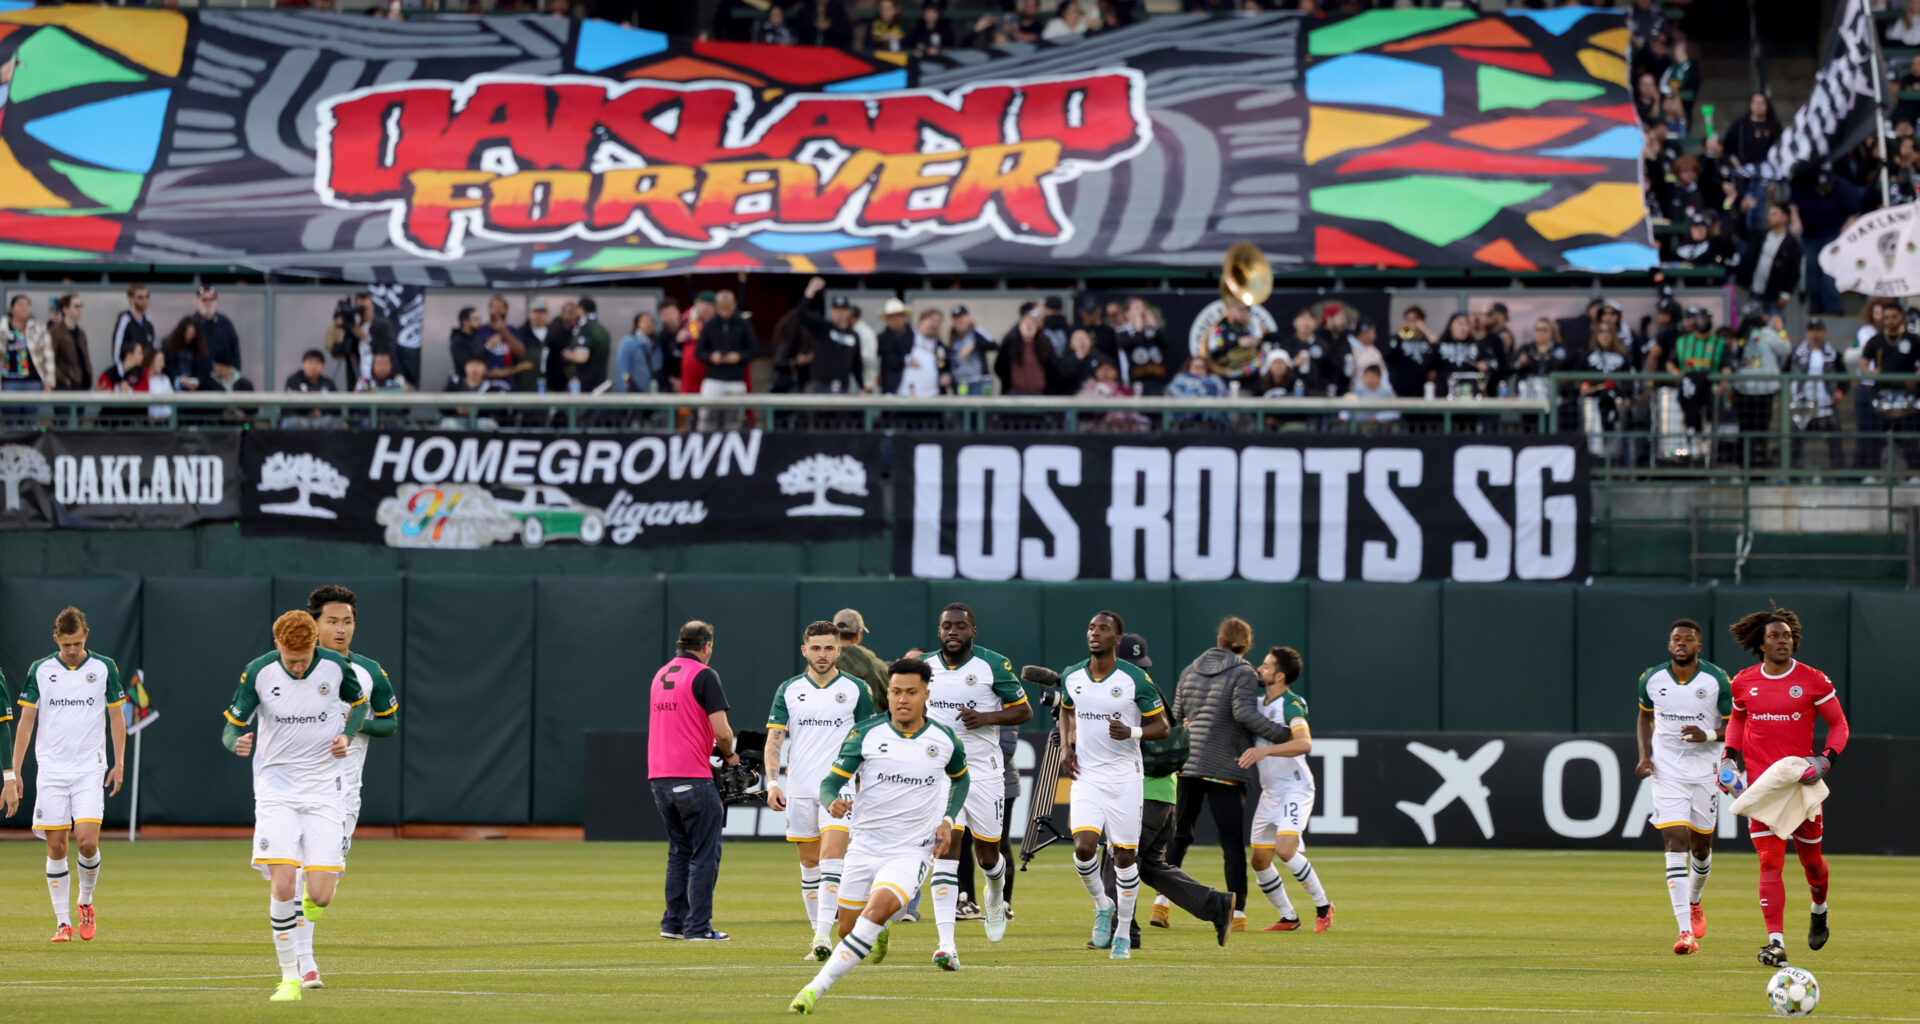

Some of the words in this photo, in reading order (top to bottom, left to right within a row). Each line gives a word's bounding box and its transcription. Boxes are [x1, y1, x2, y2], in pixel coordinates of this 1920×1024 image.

[327, 72, 1138, 197] OAKLAND
[406, 136, 1062, 250] FOREVER
[369, 429, 762, 484] HOMEGROWN
[54, 455, 224, 505] OAKLAND
[911, 444, 1082, 582] LOS
[1107, 446, 1423, 582] ROOTS
[1452, 445, 1576, 581] SG
[1132, 644, 1141, 656] S
[49, 697, 85, 706] Anthem
[930, 699, 965, 709] Anthem
[275, 714, 316, 725] Anthem
[1078, 711, 1111, 720] Anthem
[1660, 712, 1695, 722] Anthem
[1752, 713, 1790, 721] Anthem
[798, 718, 833, 727] Anthem
[877, 772, 923, 786] Anthem
[1284, 802, 1298, 818] 12
[917, 860, 927, 884] 6
